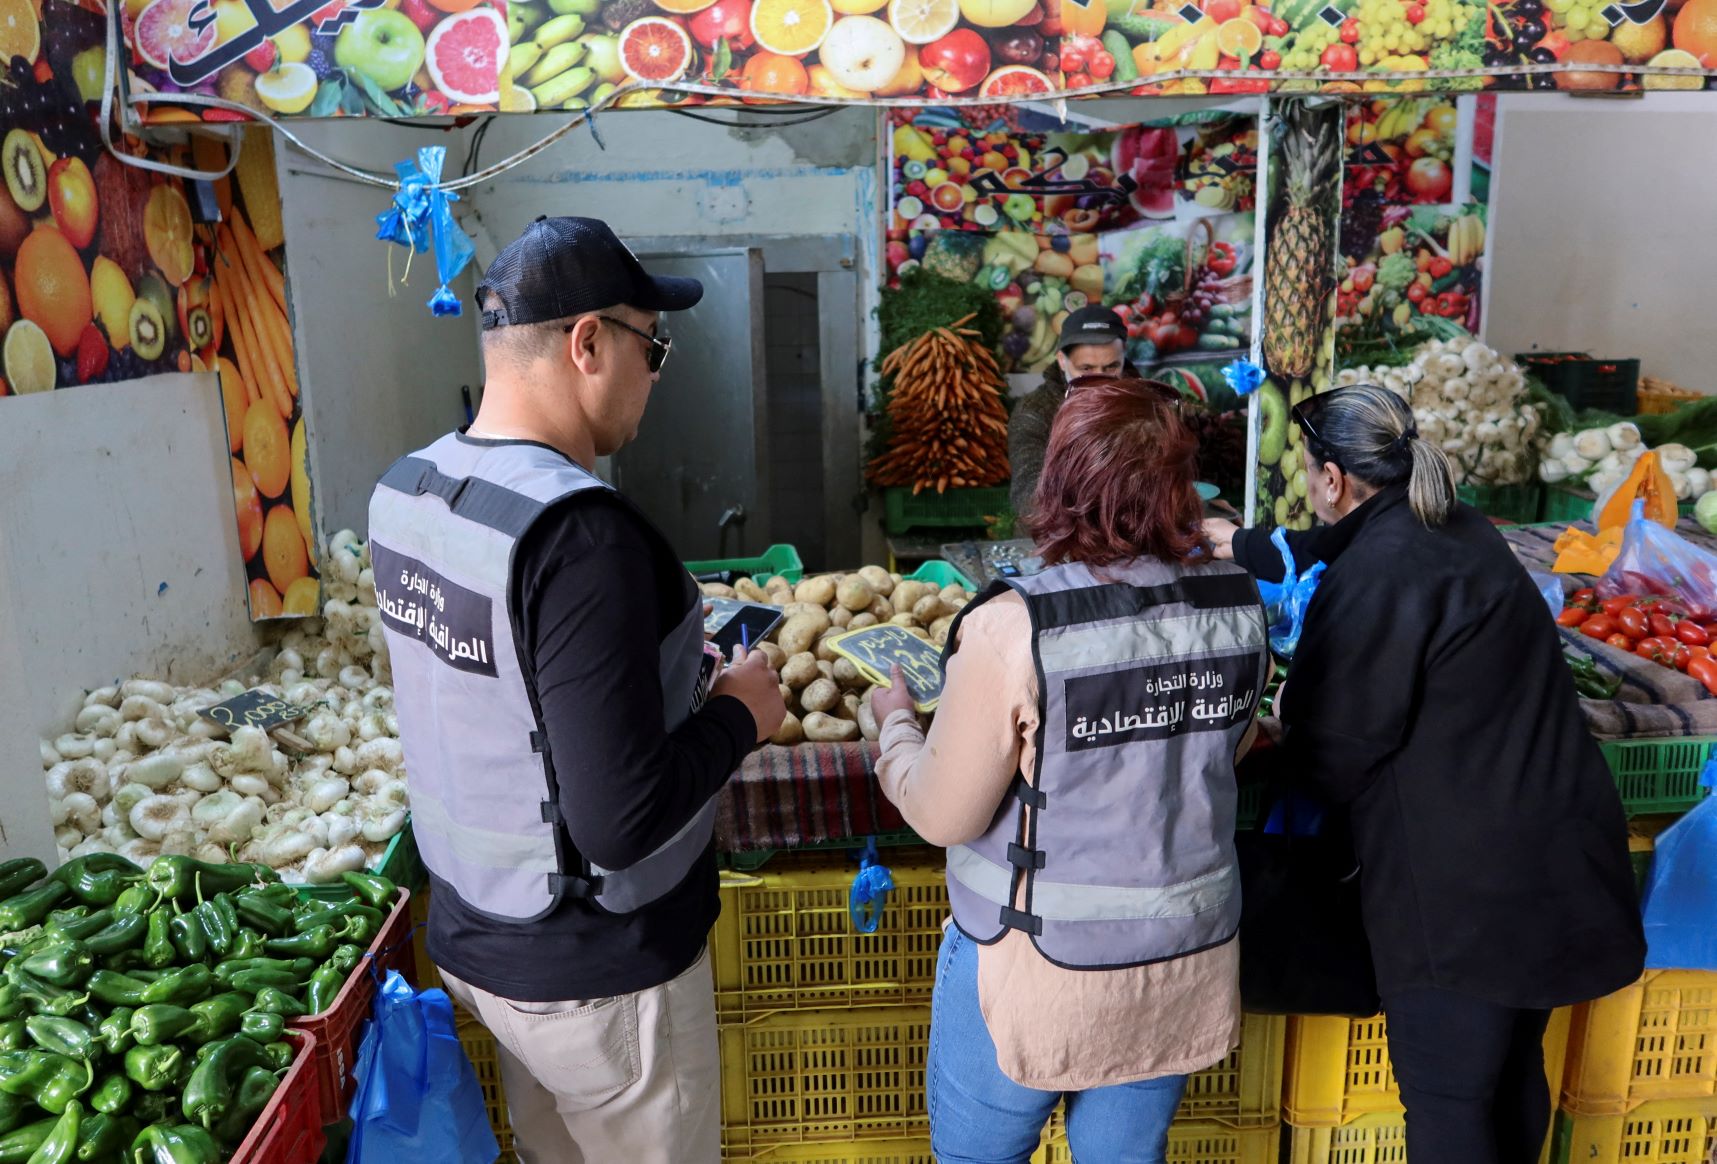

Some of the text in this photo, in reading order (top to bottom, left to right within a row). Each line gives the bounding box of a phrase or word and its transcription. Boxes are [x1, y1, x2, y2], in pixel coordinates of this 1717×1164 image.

[376, 589, 488, 664] المراقبة الإقتصاد
[1146, 670, 1224, 697] وزارة التجارة
[1072, 689, 1254, 742] المراقبة الإقتصادية
